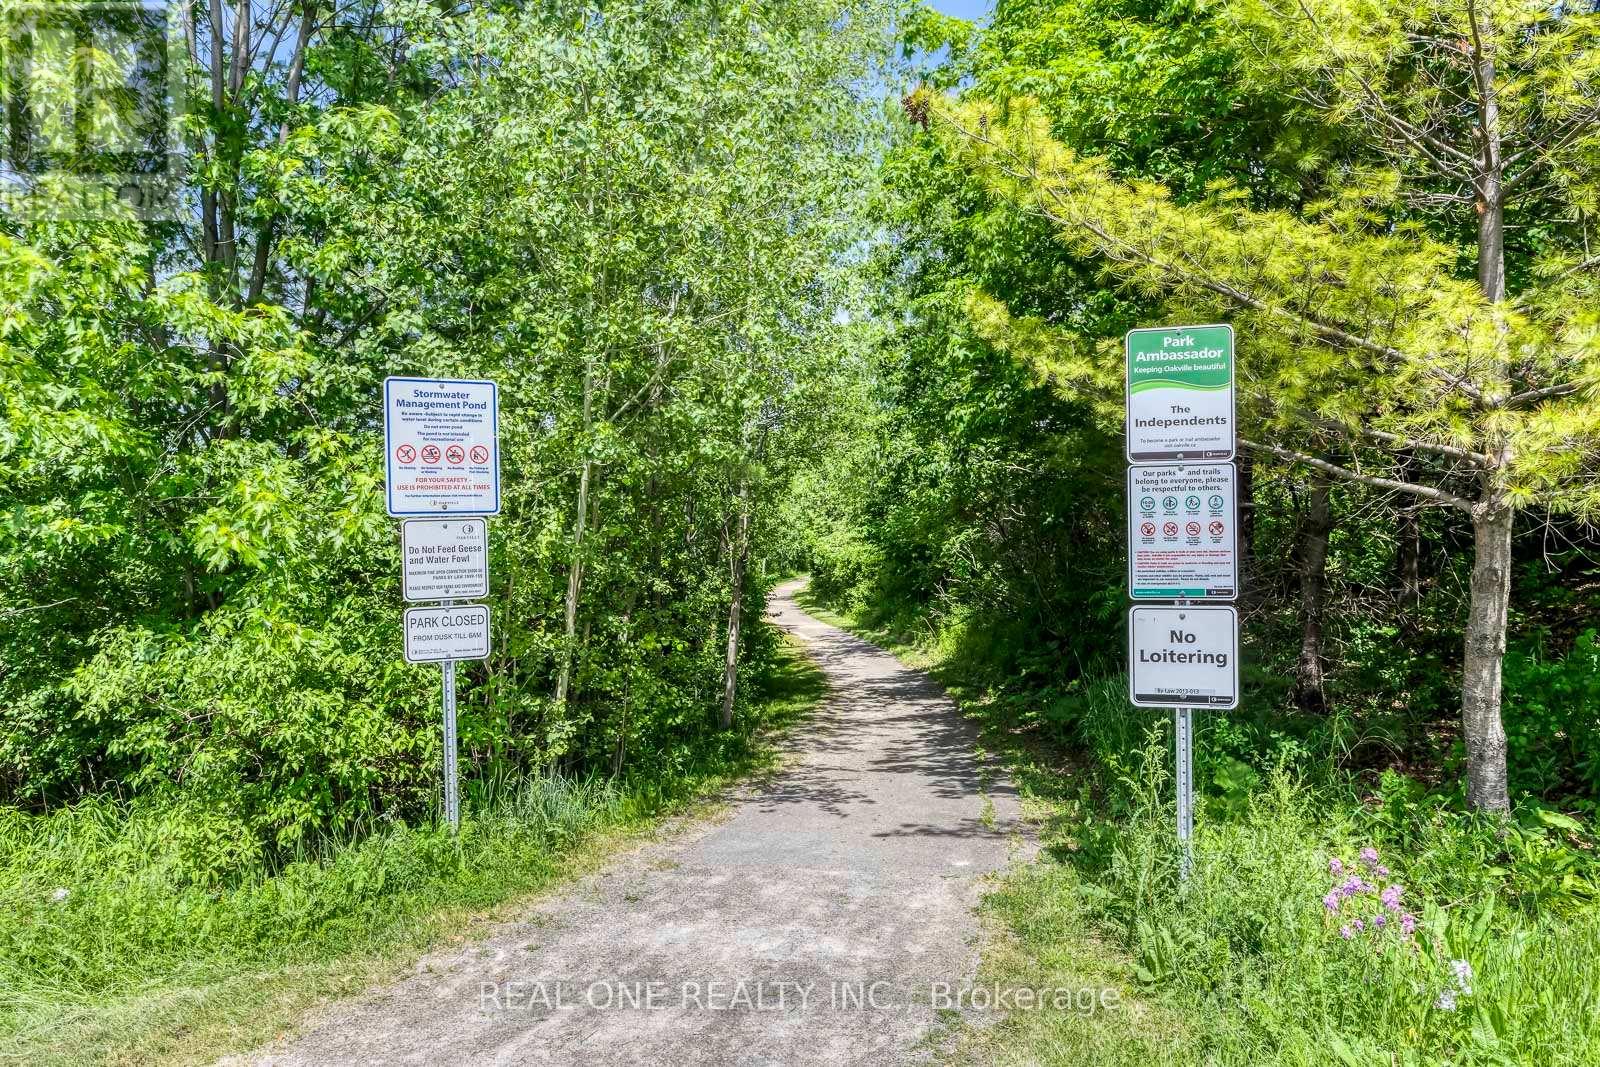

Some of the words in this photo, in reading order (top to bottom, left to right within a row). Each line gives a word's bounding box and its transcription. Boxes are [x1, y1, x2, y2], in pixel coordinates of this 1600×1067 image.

[1164, 334, 1195, 347] Park
[1136, 348, 1224, 362] Ambassador
[1134, 366, 1162, 374] Keeping
[1164, 364, 1192, 373] Oakville
[1194, 362, 1226, 371] beautiful
[414, 389, 470, 399] Stormwater
[396, 399, 460, 410] Management
[462, 401, 487, 410] Pond
[1170, 405, 1191, 414] The
[1135, 416, 1227, 428] Independents
[1157, 469, 1176, 477] parks
[409, 546, 419, 554] Do
[422, 546, 435, 554] Not
[438, 545, 456, 553] Feed
[426, 556, 449, 564] Water
[410, 617, 439, 628] PARK
[442, 614, 485, 627] CLOSED
[1170, 630, 1196, 644] No
[1140, 649, 1227, 667] Loitering
